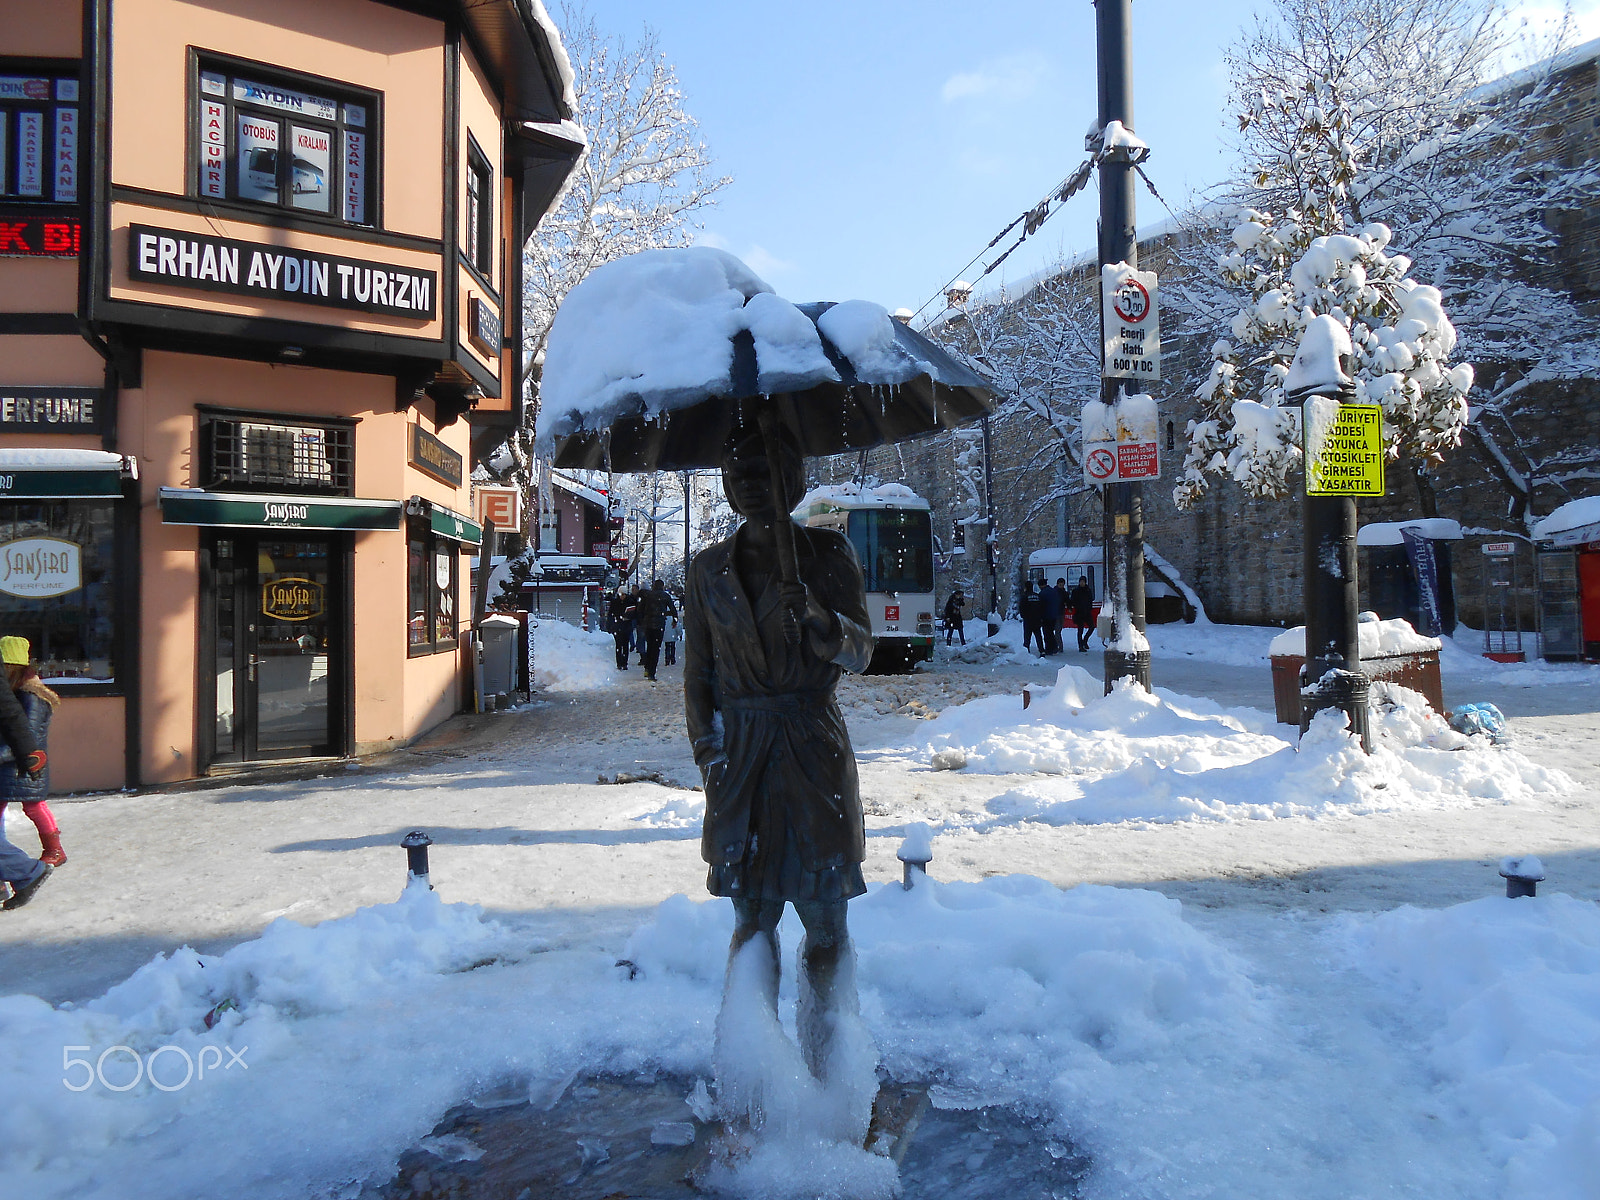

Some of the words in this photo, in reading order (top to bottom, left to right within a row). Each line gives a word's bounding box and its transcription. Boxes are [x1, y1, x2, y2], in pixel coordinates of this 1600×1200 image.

[251, 87, 303, 107] AYDIN
[242, 123, 276, 142] OTOBÜS
[60, 112, 74, 186] BALKAN
[139, 233, 240, 284] ERHAN
[247, 250, 329, 297] AYDIN
[1120, 326, 1146, 342] Enerji
[1113, 358, 1130, 371] 600
[1131, 359, 1139, 371] V
[1141, 360, 1153, 373] DC
[0, 397, 94, 423] ERFUME
[1322, 463, 1365, 476] GİRMESİ
[1320, 479, 1371, 490] YASAKTIR
[486, 496, 510, 524] E
[12, 582, 65, 590] PERFUME
